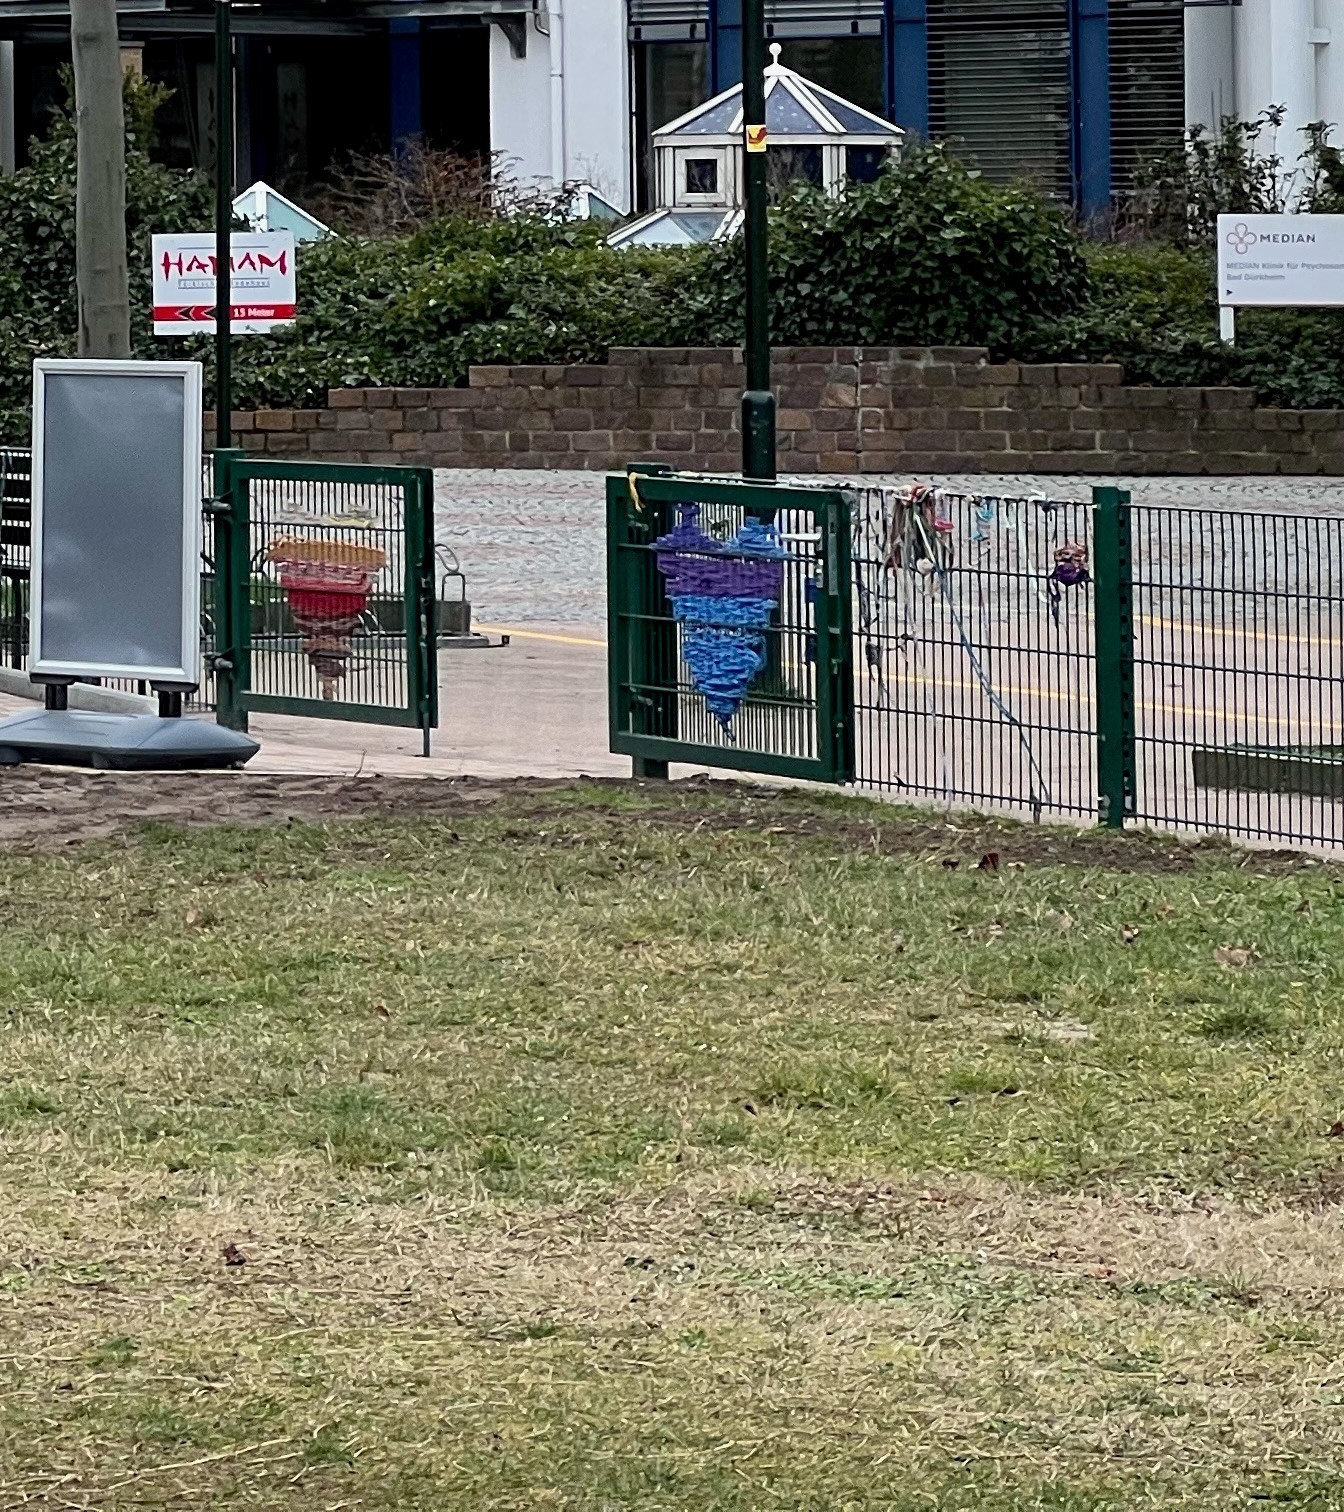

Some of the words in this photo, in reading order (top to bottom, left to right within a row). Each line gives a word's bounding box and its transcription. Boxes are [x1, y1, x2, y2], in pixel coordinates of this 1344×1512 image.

[1259, 233, 1316, 244] MEDIAN
[233, 308, 246, 318] 15
[247, 307, 275, 317] Meter
